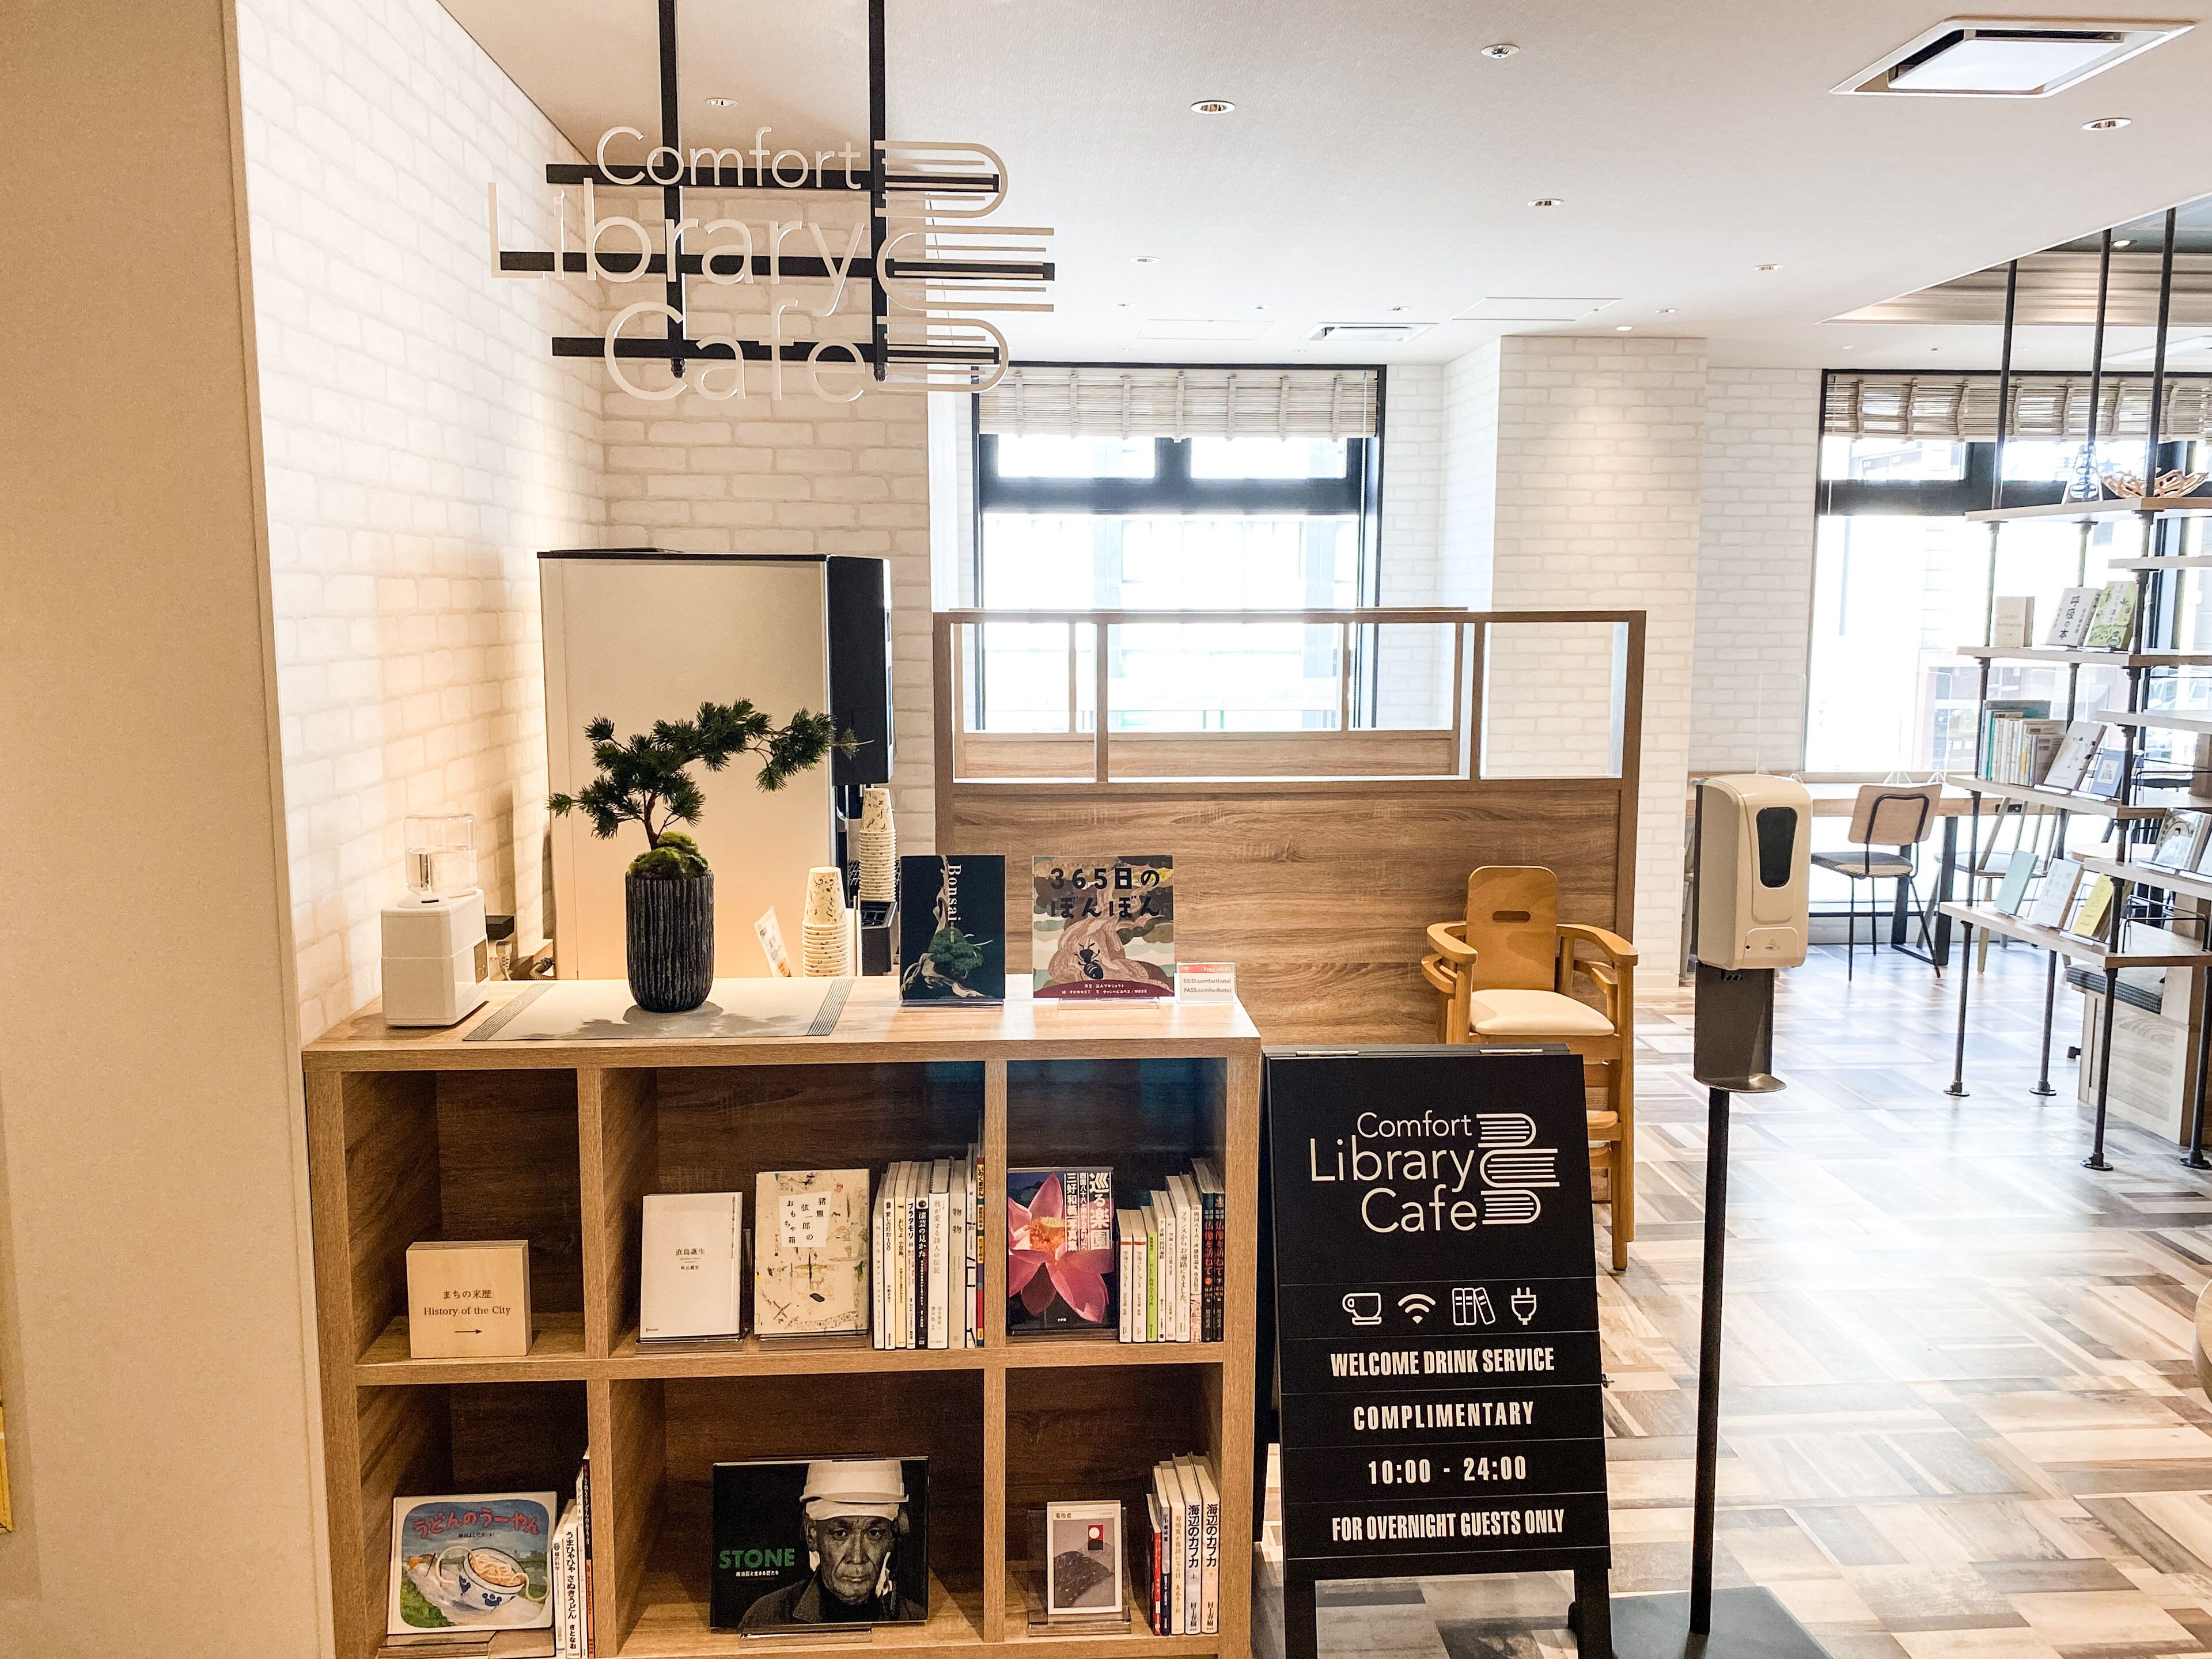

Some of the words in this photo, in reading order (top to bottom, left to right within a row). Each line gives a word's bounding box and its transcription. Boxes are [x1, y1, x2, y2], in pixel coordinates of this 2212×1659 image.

[597, 126, 861, 189] Comfort
[488, 178, 864, 317] Library
[604, 298, 868, 403] Cafe
[2058, 596, 2081, 640] 呼吸の本
[948, 864, 961, 921] Bonsai
[1050, 868, 1160, 889] 365日の
[1050, 896, 1160, 919] ぼんぼん
[1357, 1110, 1472, 1138] Comfort
[1310, 1135, 1475, 1192] Library
[1361, 1184, 1477, 1233] Cafe
[424, 1307, 458, 1316] History
[461, 1306, 471, 1315] of
[474, 1306, 488, 1315] the
[492, 1306, 511, 1316] City
[443, 1289, 492, 1300] まちの来歴
[1331, 1351, 1419, 1377] WELCOME
[1424, 1349, 1479, 1374] DRINK
[1482, 1347, 1555, 1373] SERVICE
[1354, 1401, 1533, 1430] COMPLIMENTARY
[1368, 1459, 1431, 1484] 10:00
[1464, 1456, 1527, 1481] 24:00
[413, 1507, 540, 1539] うどんのうーやん
[1188, 1504, 1200, 1568] 海辺のカフカ
[1206, 1503, 1218, 1567] 海辺のカフカ
[1332, 1516, 1363, 1541] FOR
[1367, 1512, 1457, 1540] OVERNIGHT
[1460, 1510, 1521, 1537] GUESTS
[1525, 1509, 1565, 1535] ONLY
[566, 1531, 576, 1573] うまひゃひゃ
[719, 1548, 795, 1569] STONE
[567, 1575, 577, 1619] さぬきうどん
